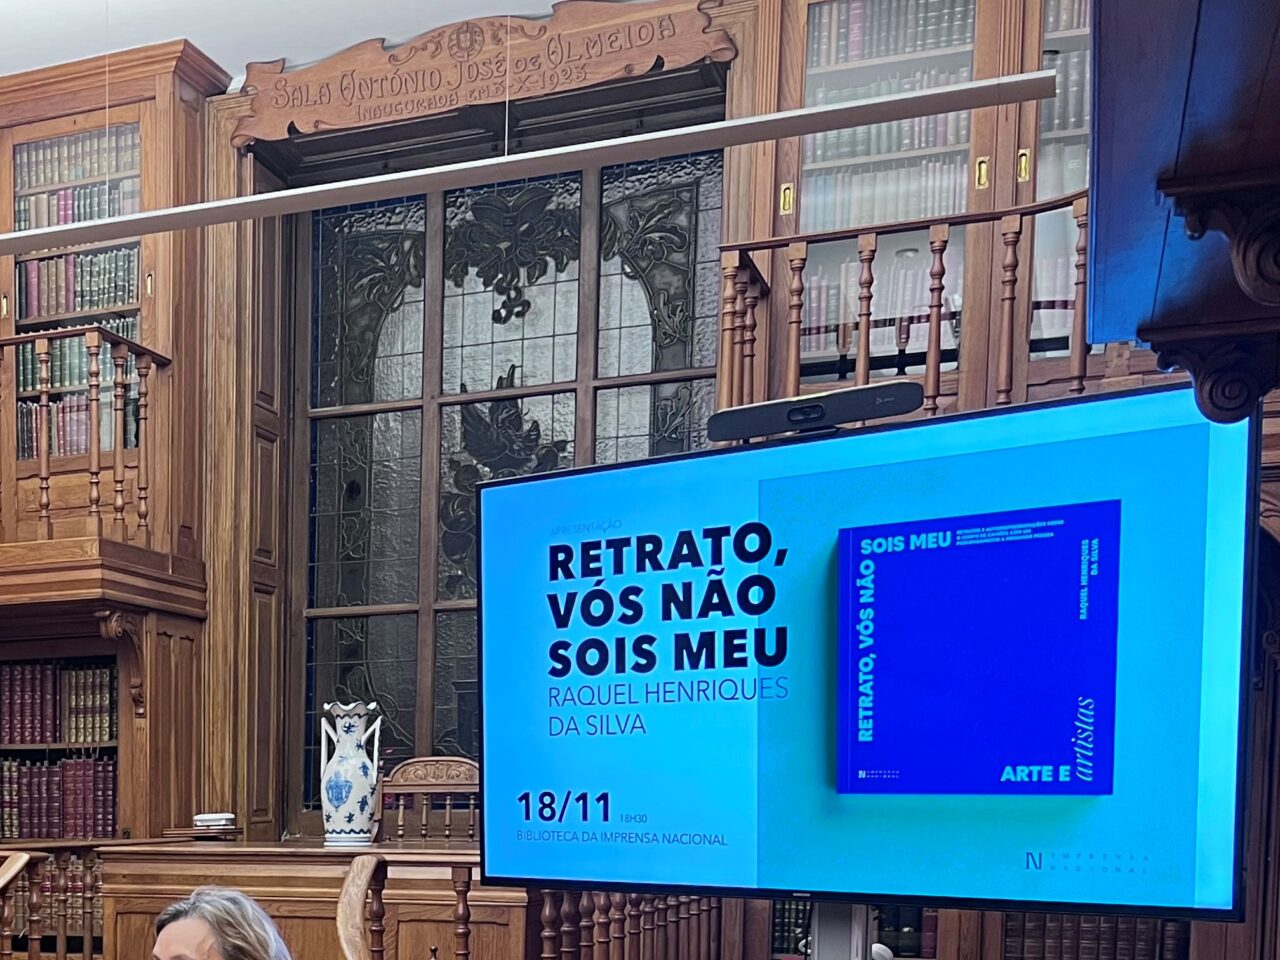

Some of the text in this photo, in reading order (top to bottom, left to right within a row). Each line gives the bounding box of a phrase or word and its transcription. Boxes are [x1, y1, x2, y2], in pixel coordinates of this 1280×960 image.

[272, 78, 331, 109] SALA
[545, 14, 676, 69] ALMEIDA
[549, 522, 788, 581] RETRATO,
[861, 536, 904, 555] SOIS
[910, 531, 951, 550] MEU
[547, 567, 775, 629] VÓS NÃO
[1080, 587, 1089, 620] RAQUEL
[548, 626, 788, 678] SOIS MEU
[856, 559, 876, 742] RETRATO, VÓS NÃO
[549, 676, 788, 707] RAQUEL HENRIQUES
[549, 713, 646, 736] DA SILVA
[1071, 697, 1094, 781] artistas
[1000, 766, 1070, 781] ARTE E
[517, 790, 609, 823] 18/11
[517, 830, 727, 845] BIBLIOTECA DA IMPRENSA NACIONAL
